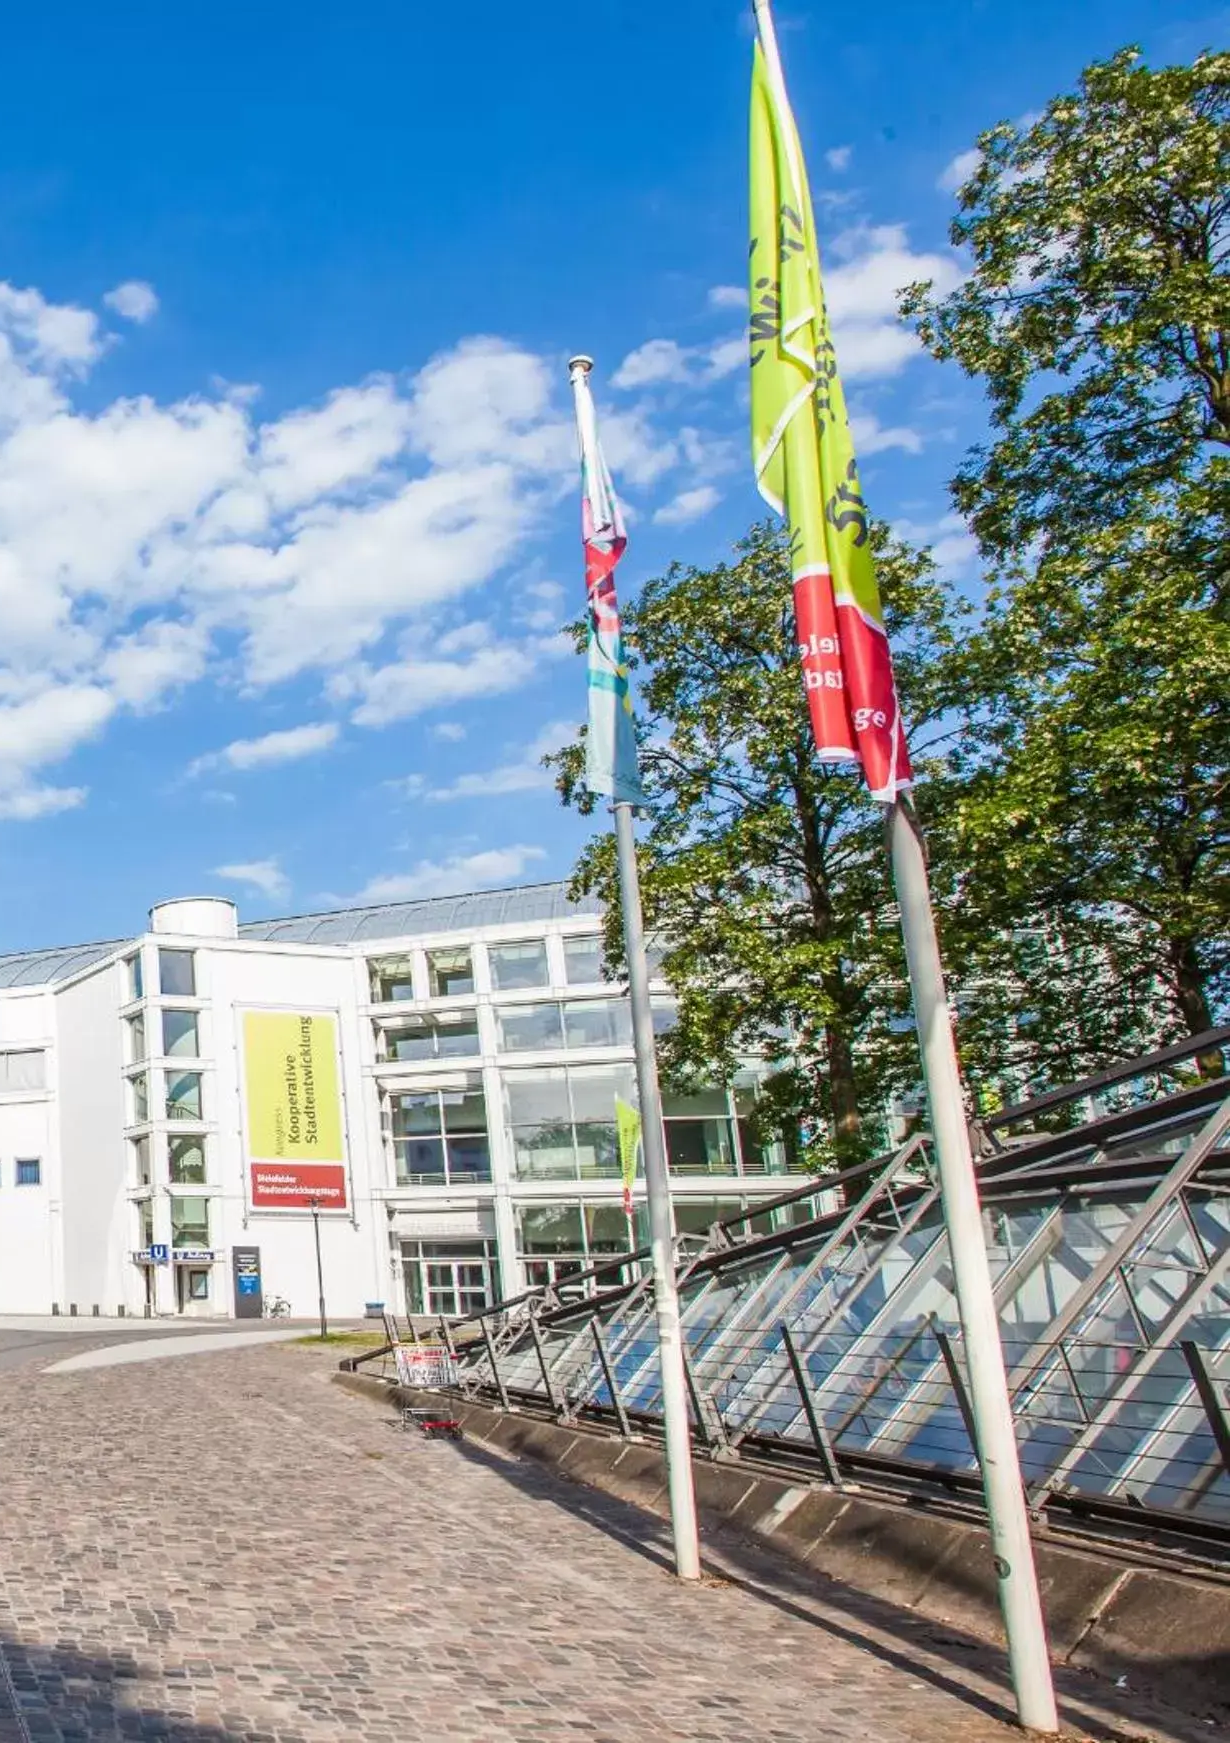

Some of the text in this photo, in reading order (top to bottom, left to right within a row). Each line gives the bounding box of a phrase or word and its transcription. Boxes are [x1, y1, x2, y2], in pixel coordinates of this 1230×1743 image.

[286, 1054, 301, 1144] Kooperative
[300, 1016, 318, 1145] Stadtentwicklung
[153, 1244, 165, 1259] U
